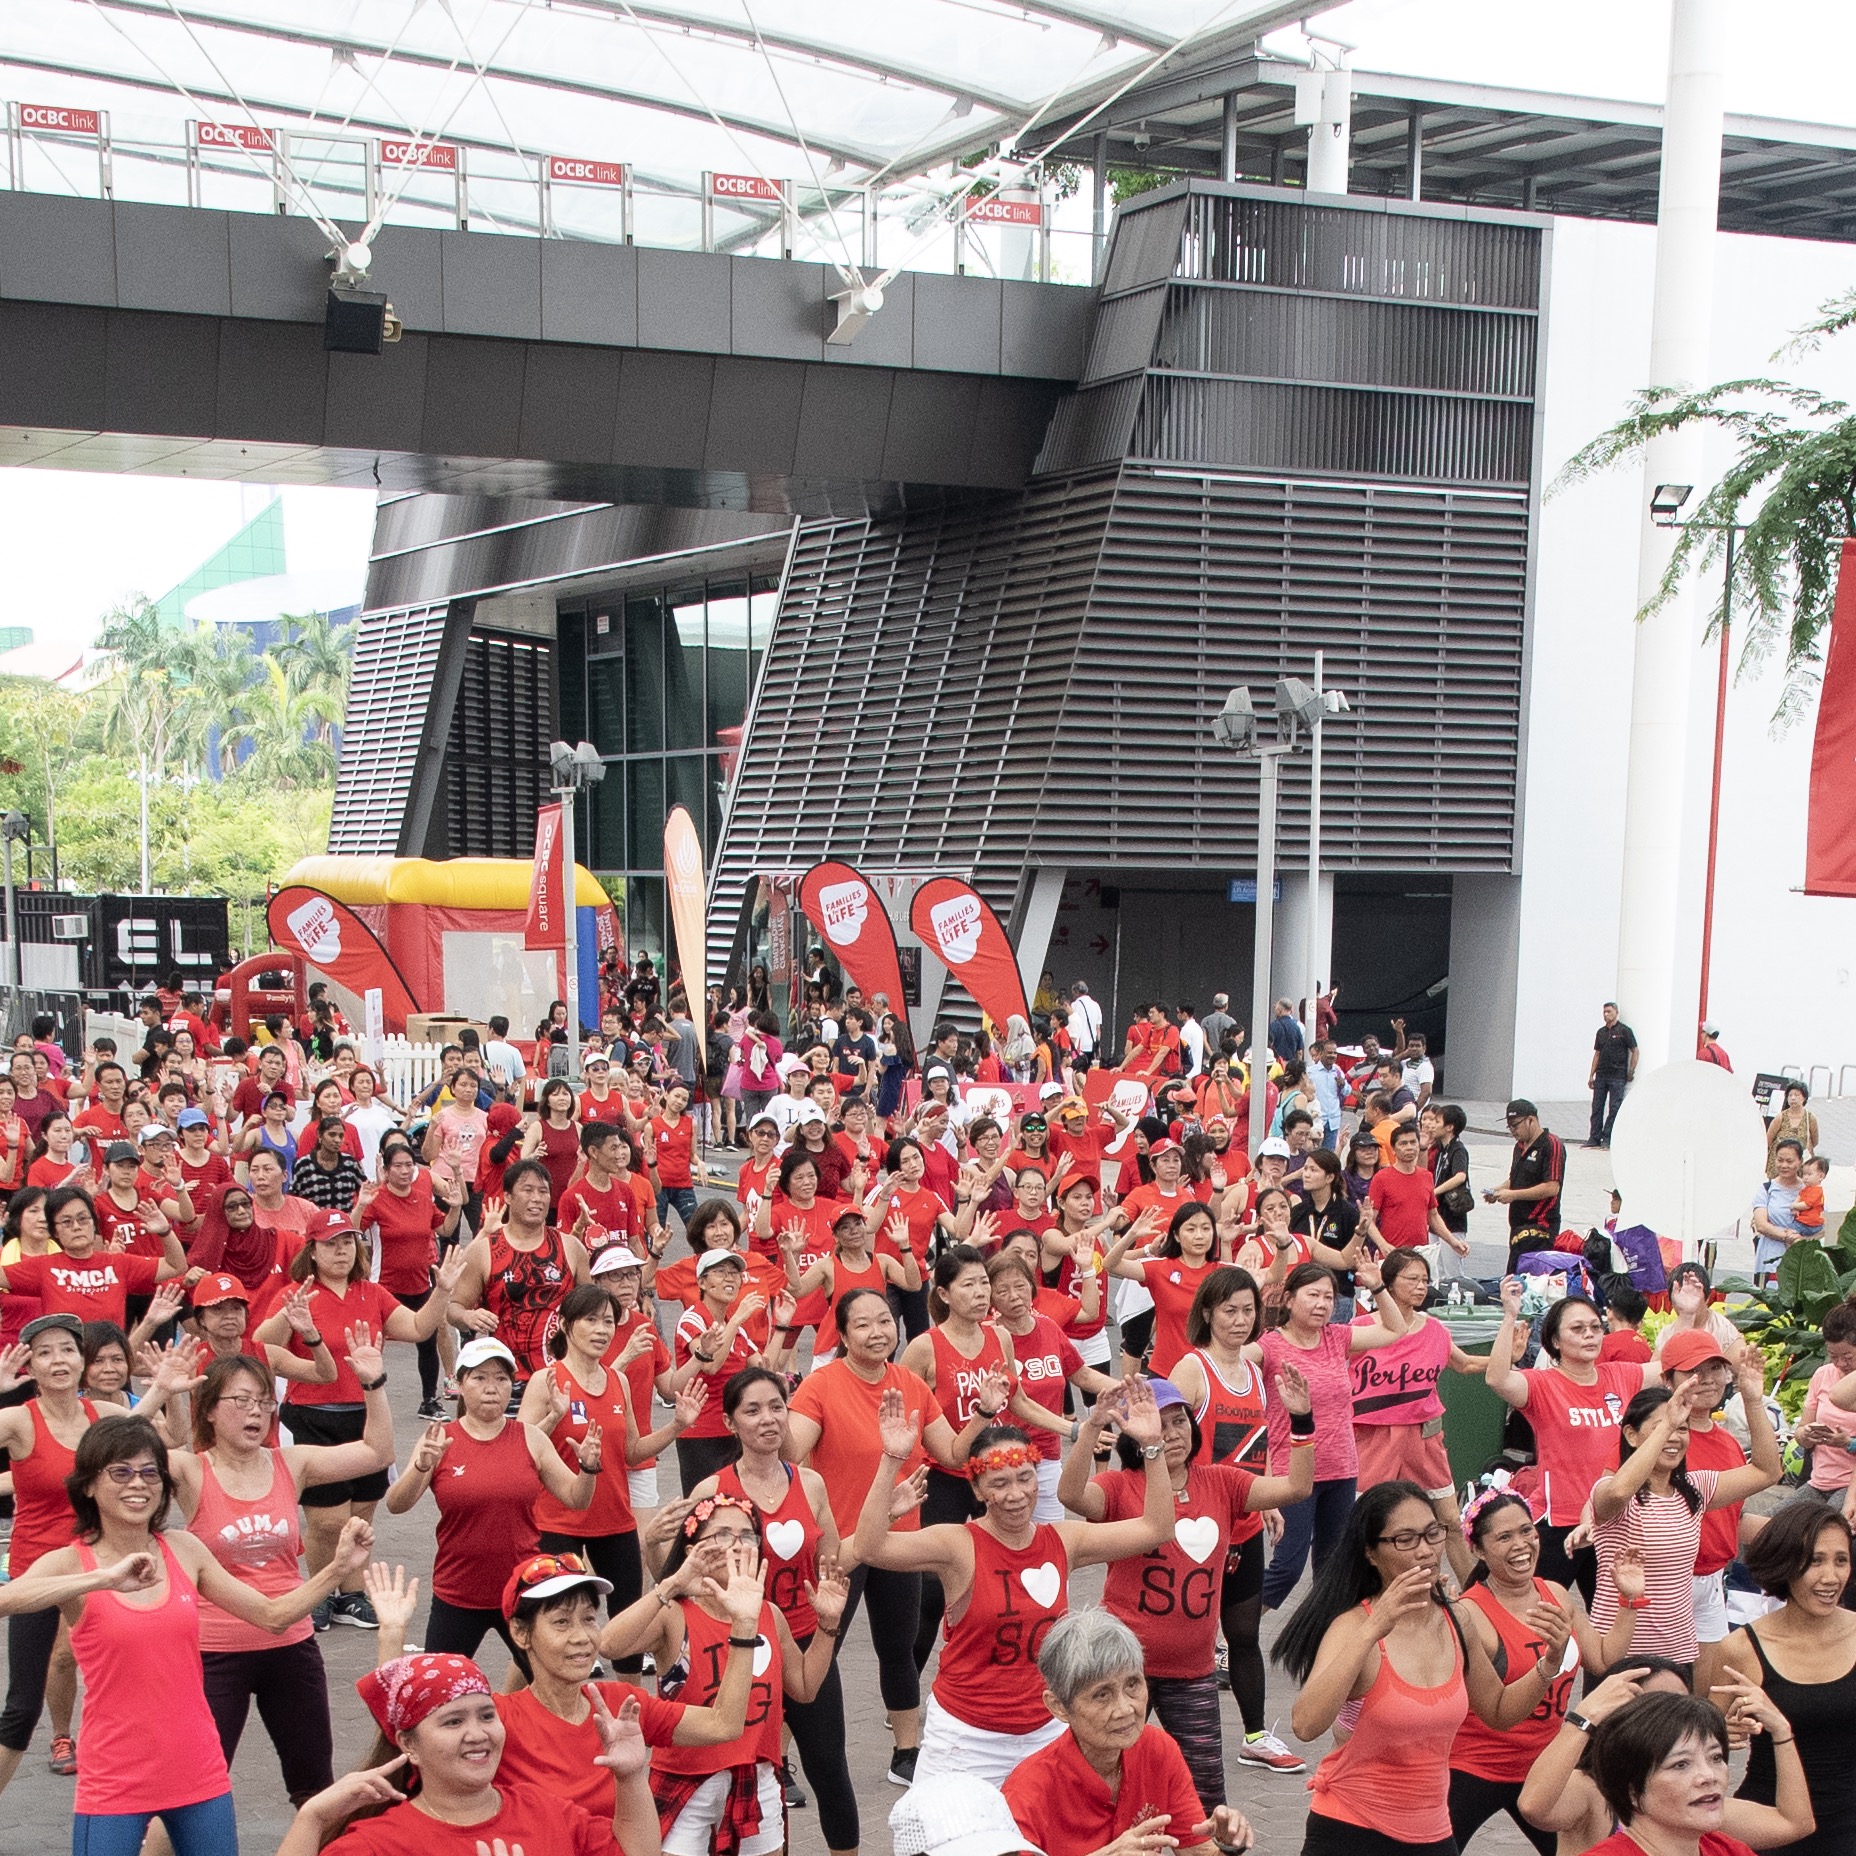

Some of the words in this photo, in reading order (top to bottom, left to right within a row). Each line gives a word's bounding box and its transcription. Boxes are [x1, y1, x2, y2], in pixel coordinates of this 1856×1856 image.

[22, 108, 68, 128] OCBC
[70, 113, 95, 131] link
[430, 149, 452, 165] link
[553, 160, 594, 179] OCBC
[597, 166, 618, 182] link
[716, 176, 756, 194] OCBC
[1013, 207, 1032, 221] link
[541, 824, 552, 873] OCBC
[536, 876, 549, 932] square
[825, 889, 862, 912] FAMILIES
[297, 904, 327, 938] FAMILIES
[827, 903, 856, 926] LIFE
[938, 903, 975, 932] FAMILIES
[303, 920, 329, 950] LIFE
[941, 919, 970, 946] LIFE
[971, 1098, 1006, 1115] FAMES
[50, 1265, 120, 1288] YMCA
[1215, 1405, 1265, 1421] Bodypu
[1568, 1406, 1633, 1428] STYLE
[219, 1514, 290, 1542] PUMA
[994, 1569, 1021, 1618] I
[1137, 1565, 1216, 1620] SG
